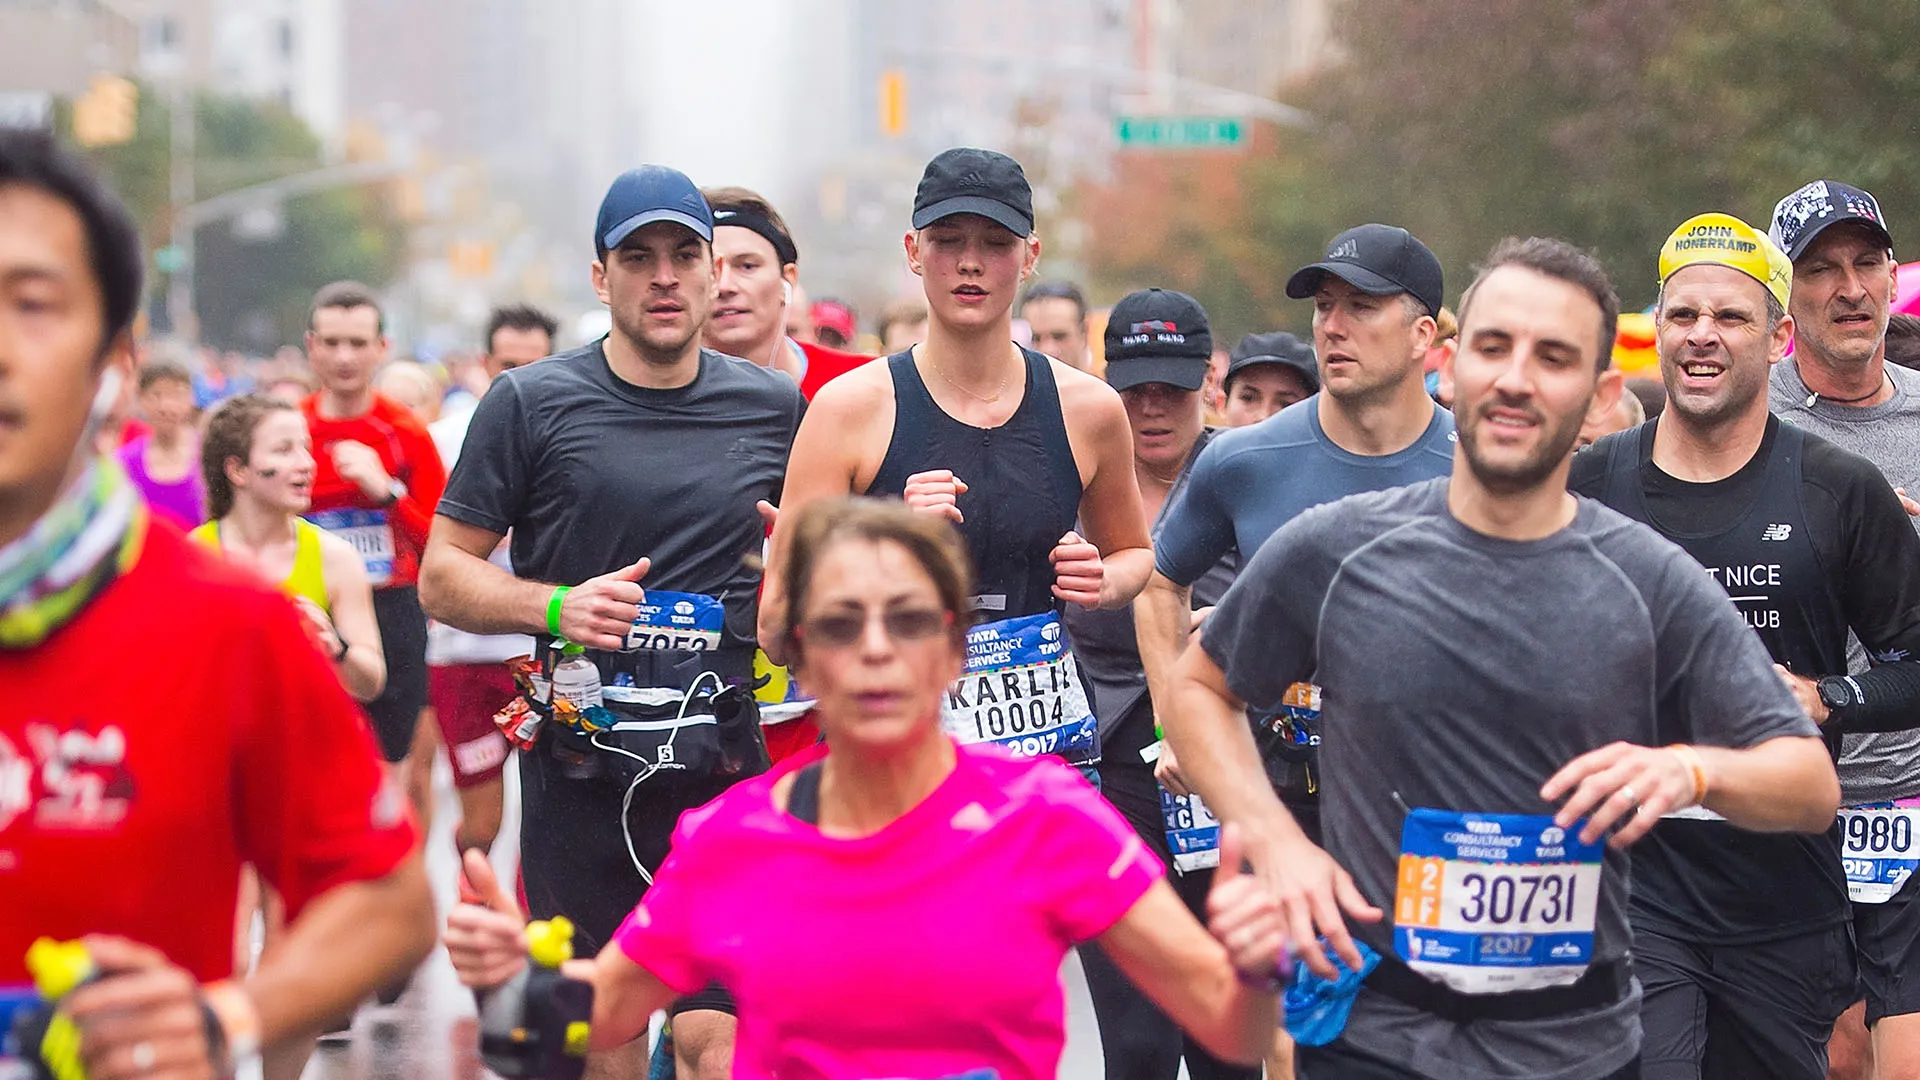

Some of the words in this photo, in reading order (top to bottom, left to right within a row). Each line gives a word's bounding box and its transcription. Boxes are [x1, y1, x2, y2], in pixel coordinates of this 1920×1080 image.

[1687, 226, 1732, 237] JOHN
[1726, 564, 1781, 587] NICE
[1737, 610, 1781, 629] LUB
[965, 628, 1000, 644] TATA
[966, 638, 1023, 656] SULTANCY
[974, 694, 1063, 739] 10004
[1007, 732, 1058, 757] 2017
[1177, 808, 1192, 829] C
[1466, 821, 1502, 834] TATA
[1443, 832, 1523, 849] CONSULTANCY
[1456, 846, 1509, 860] SERVICES
[1535, 847, 1566, 858] TATA
[1421, 862, 1439, 891] 2
[1460, 872, 1576, 924] 30731
[1419, 895, 1436, 923] F
[1480, 935, 1535, 956] 2017
